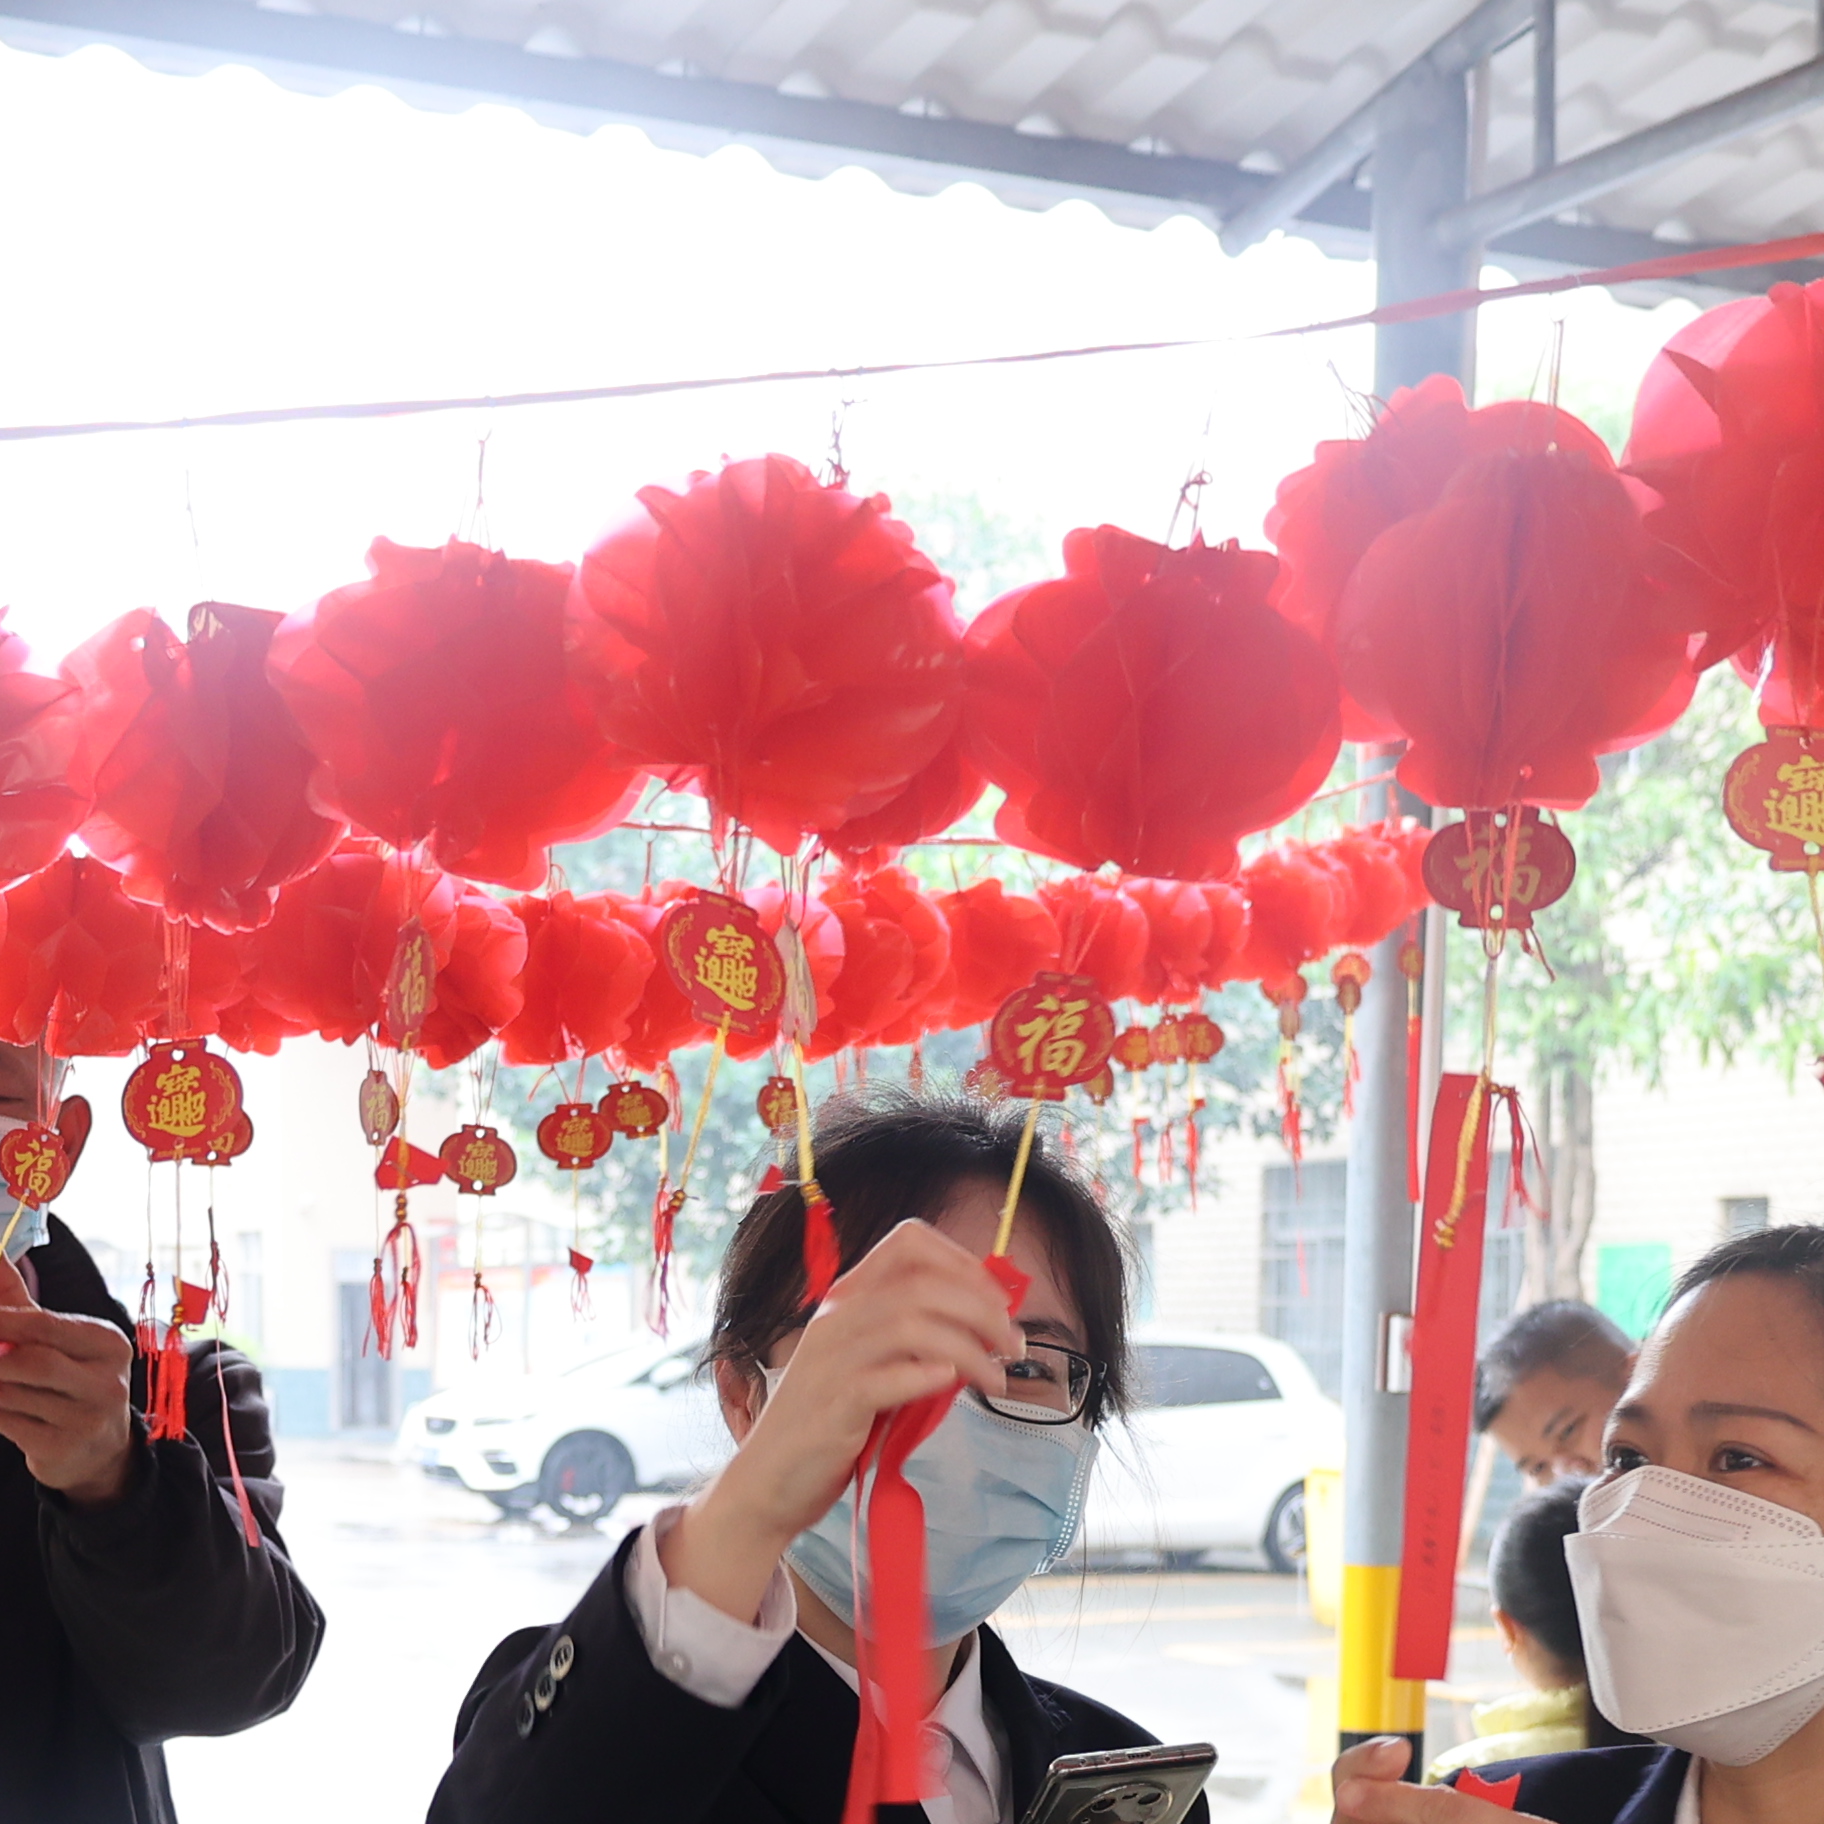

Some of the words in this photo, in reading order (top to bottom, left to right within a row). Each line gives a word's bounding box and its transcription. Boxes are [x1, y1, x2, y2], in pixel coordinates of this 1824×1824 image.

[1453, 823, 1541, 906] 福
[1014, 994, 1091, 1078] 福
[15, 1139, 56, 1198] 福
